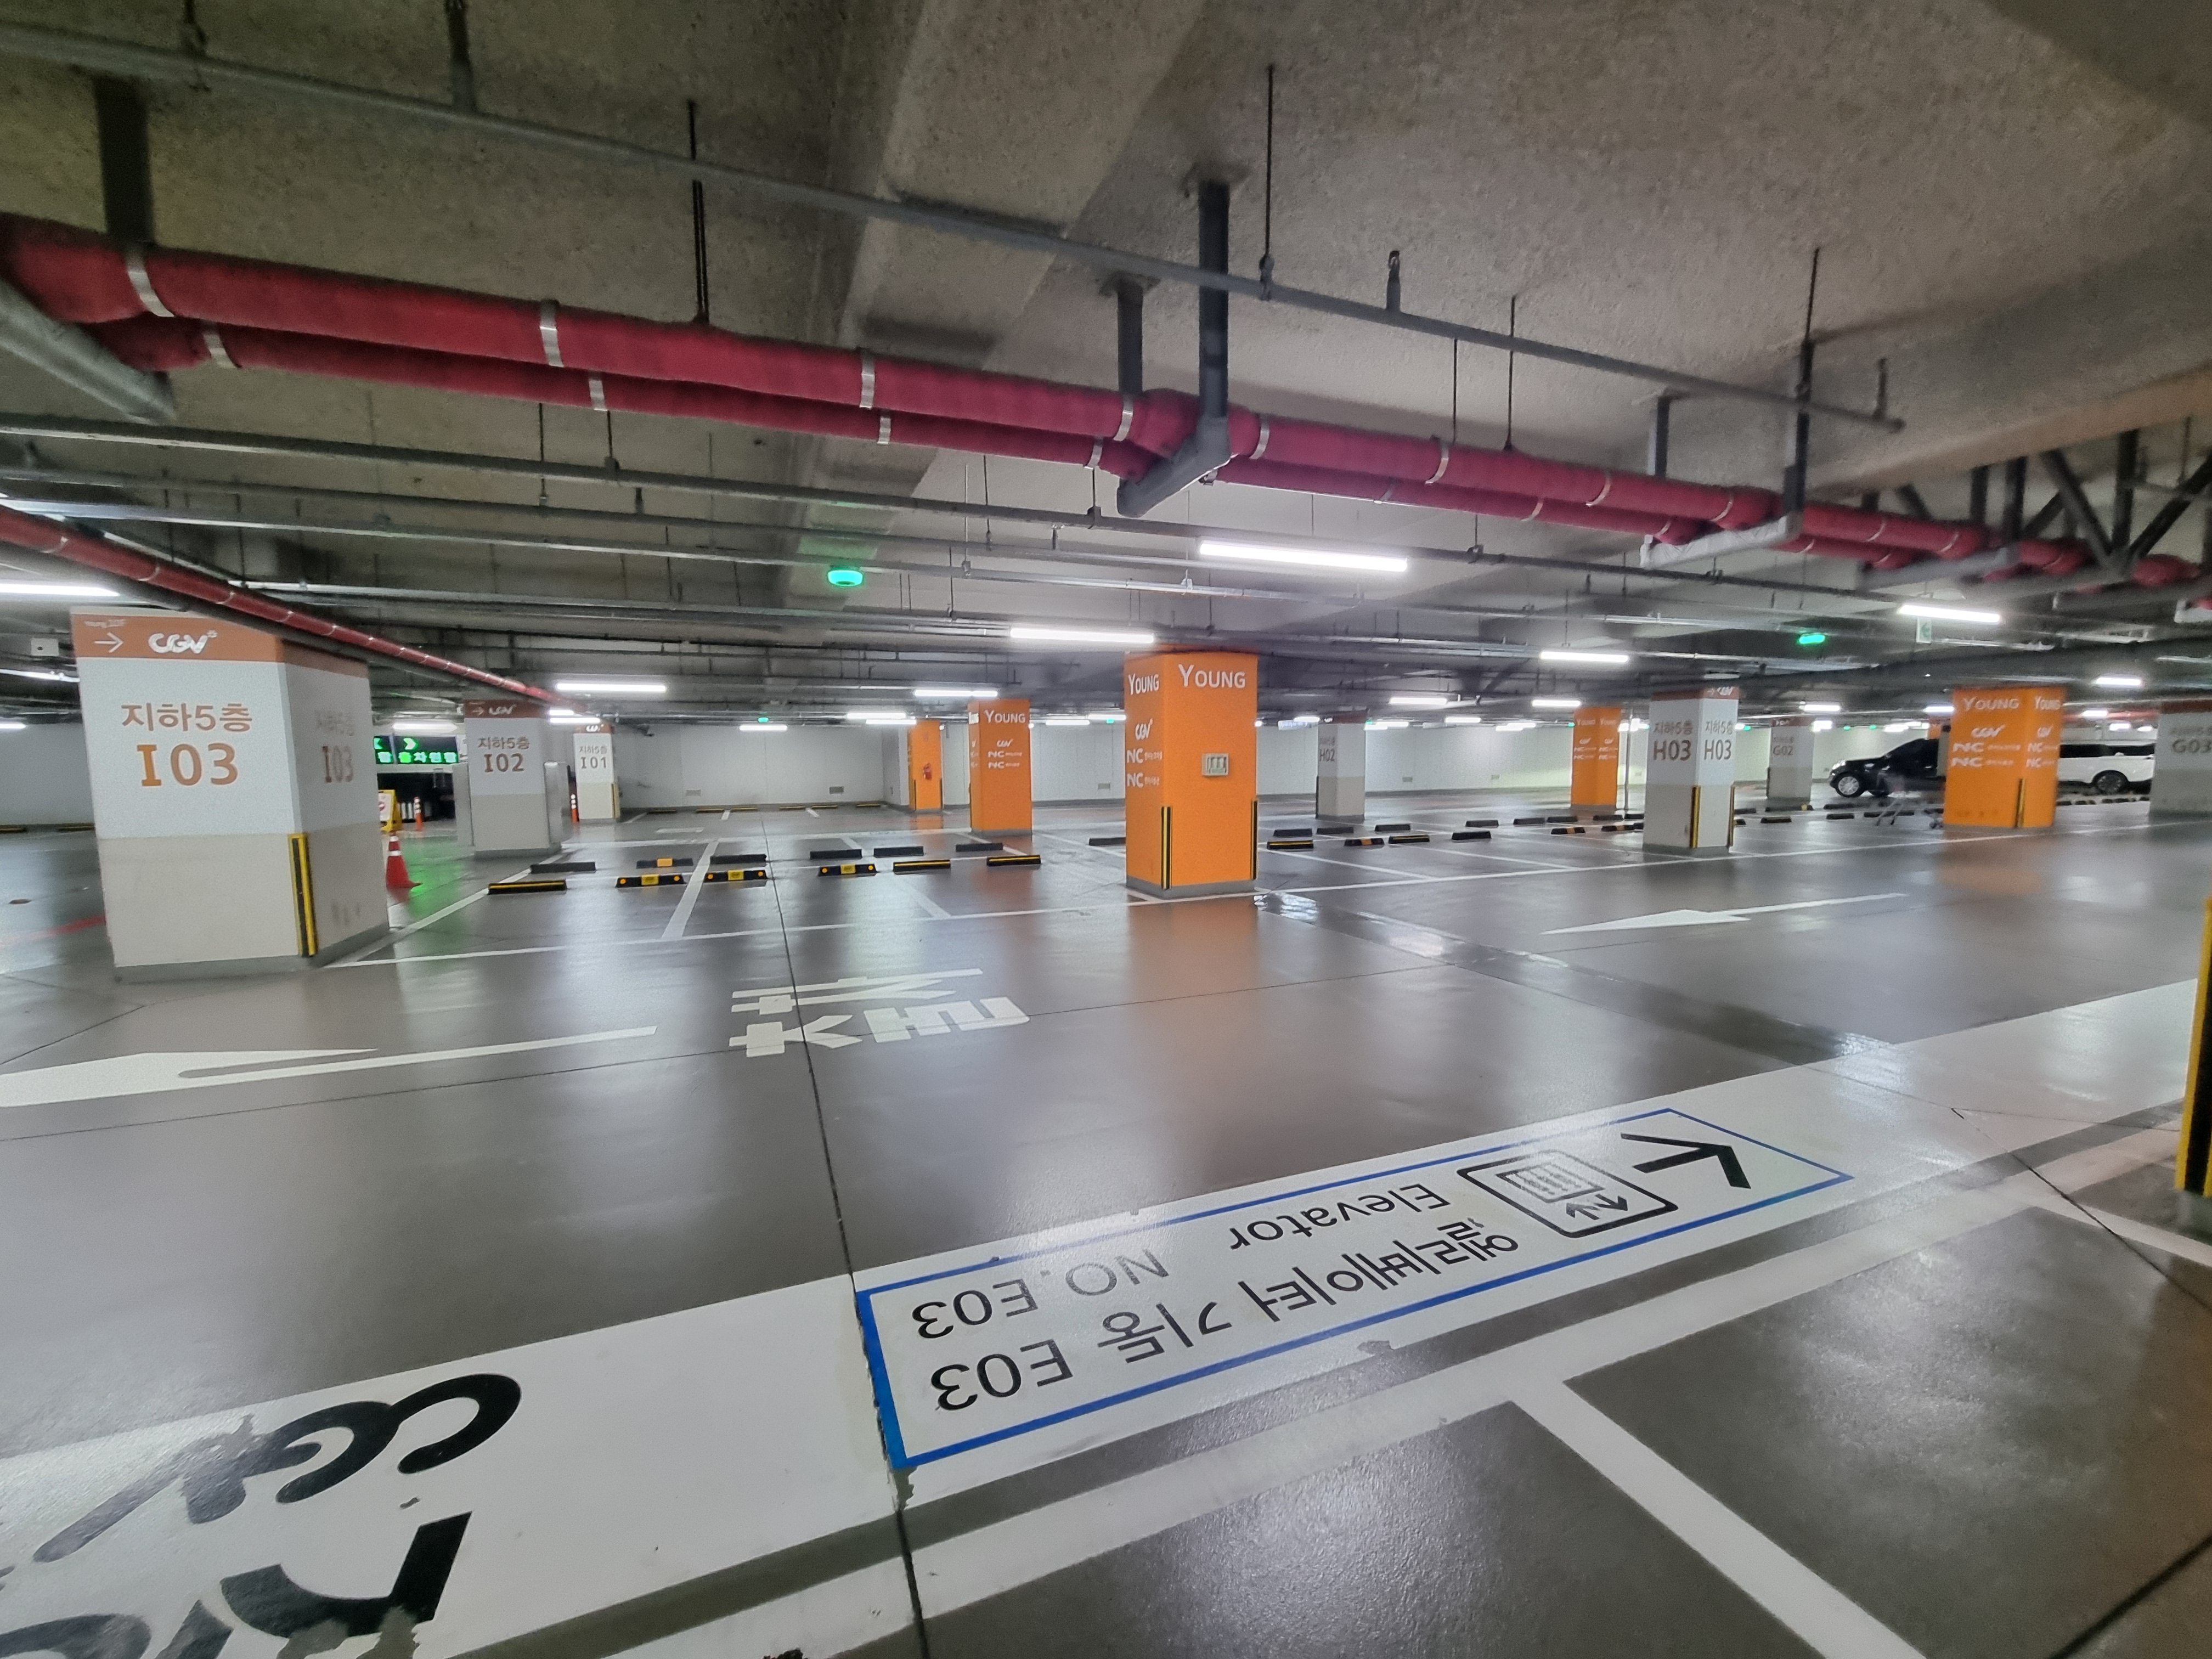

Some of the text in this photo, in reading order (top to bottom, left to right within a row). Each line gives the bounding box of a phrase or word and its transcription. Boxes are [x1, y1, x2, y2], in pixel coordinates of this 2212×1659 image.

[148, 631, 217, 654] CGV
[1128, 674, 1159, 695] YOUNG
[1178, 664, 1246, 689] YOUNG
[121, 703, 252, 732] 지하5층
[1319, 749, 1335, 761] H02
[1653, 740, 1691, 761] H03
[1704, 739, 1731, 760] H03
[1773, 746, 1793, 755] G02
[137, 743, 239, 787] I03
[322, 746, 354, 783] I03
[484, 753, 525, 773] I02
[580, 757, 606, 769] I01
[1229, 1183, 1451, 1250] Elevator
[931, 1219, 1519, 1411] 엘리베이터 기둥 E03
